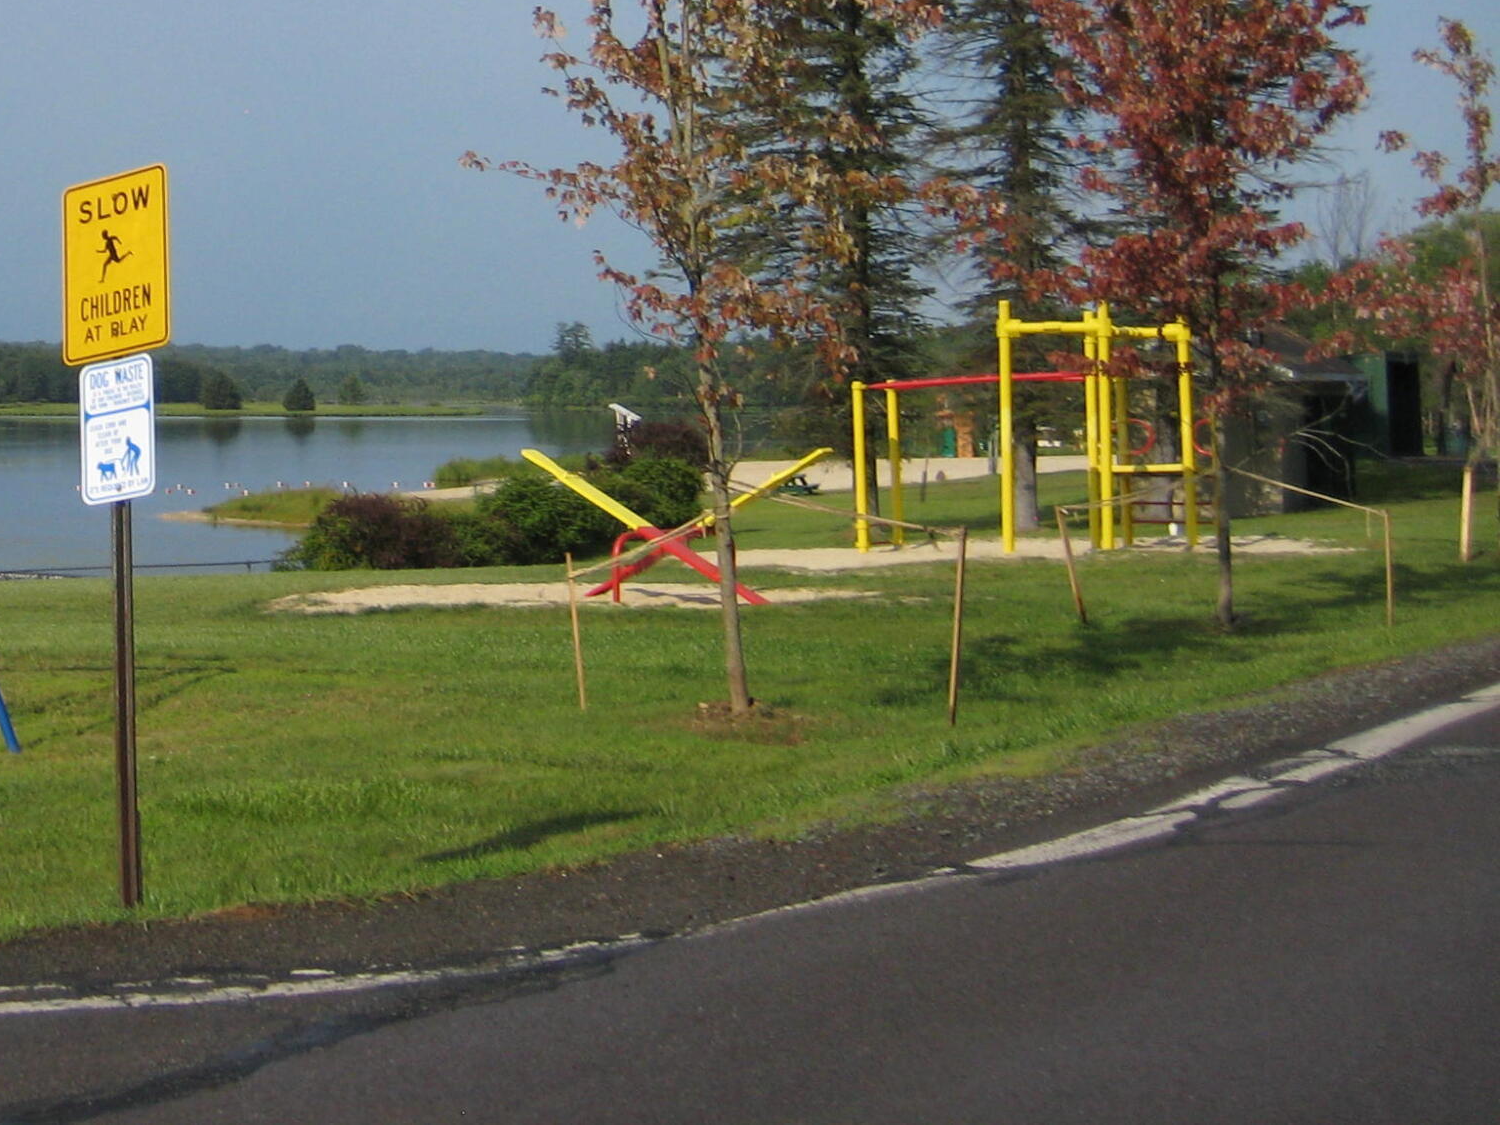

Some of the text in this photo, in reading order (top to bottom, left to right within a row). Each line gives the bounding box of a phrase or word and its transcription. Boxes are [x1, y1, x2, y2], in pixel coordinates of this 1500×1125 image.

[79, 184, 149, 224] SLOW
[81, 283, 151, 322] CHILDREN
[84, 325, 102, 344] AT
[90, 371, 109, 390] DOG
[115, 362, 144, 384] WASTE
